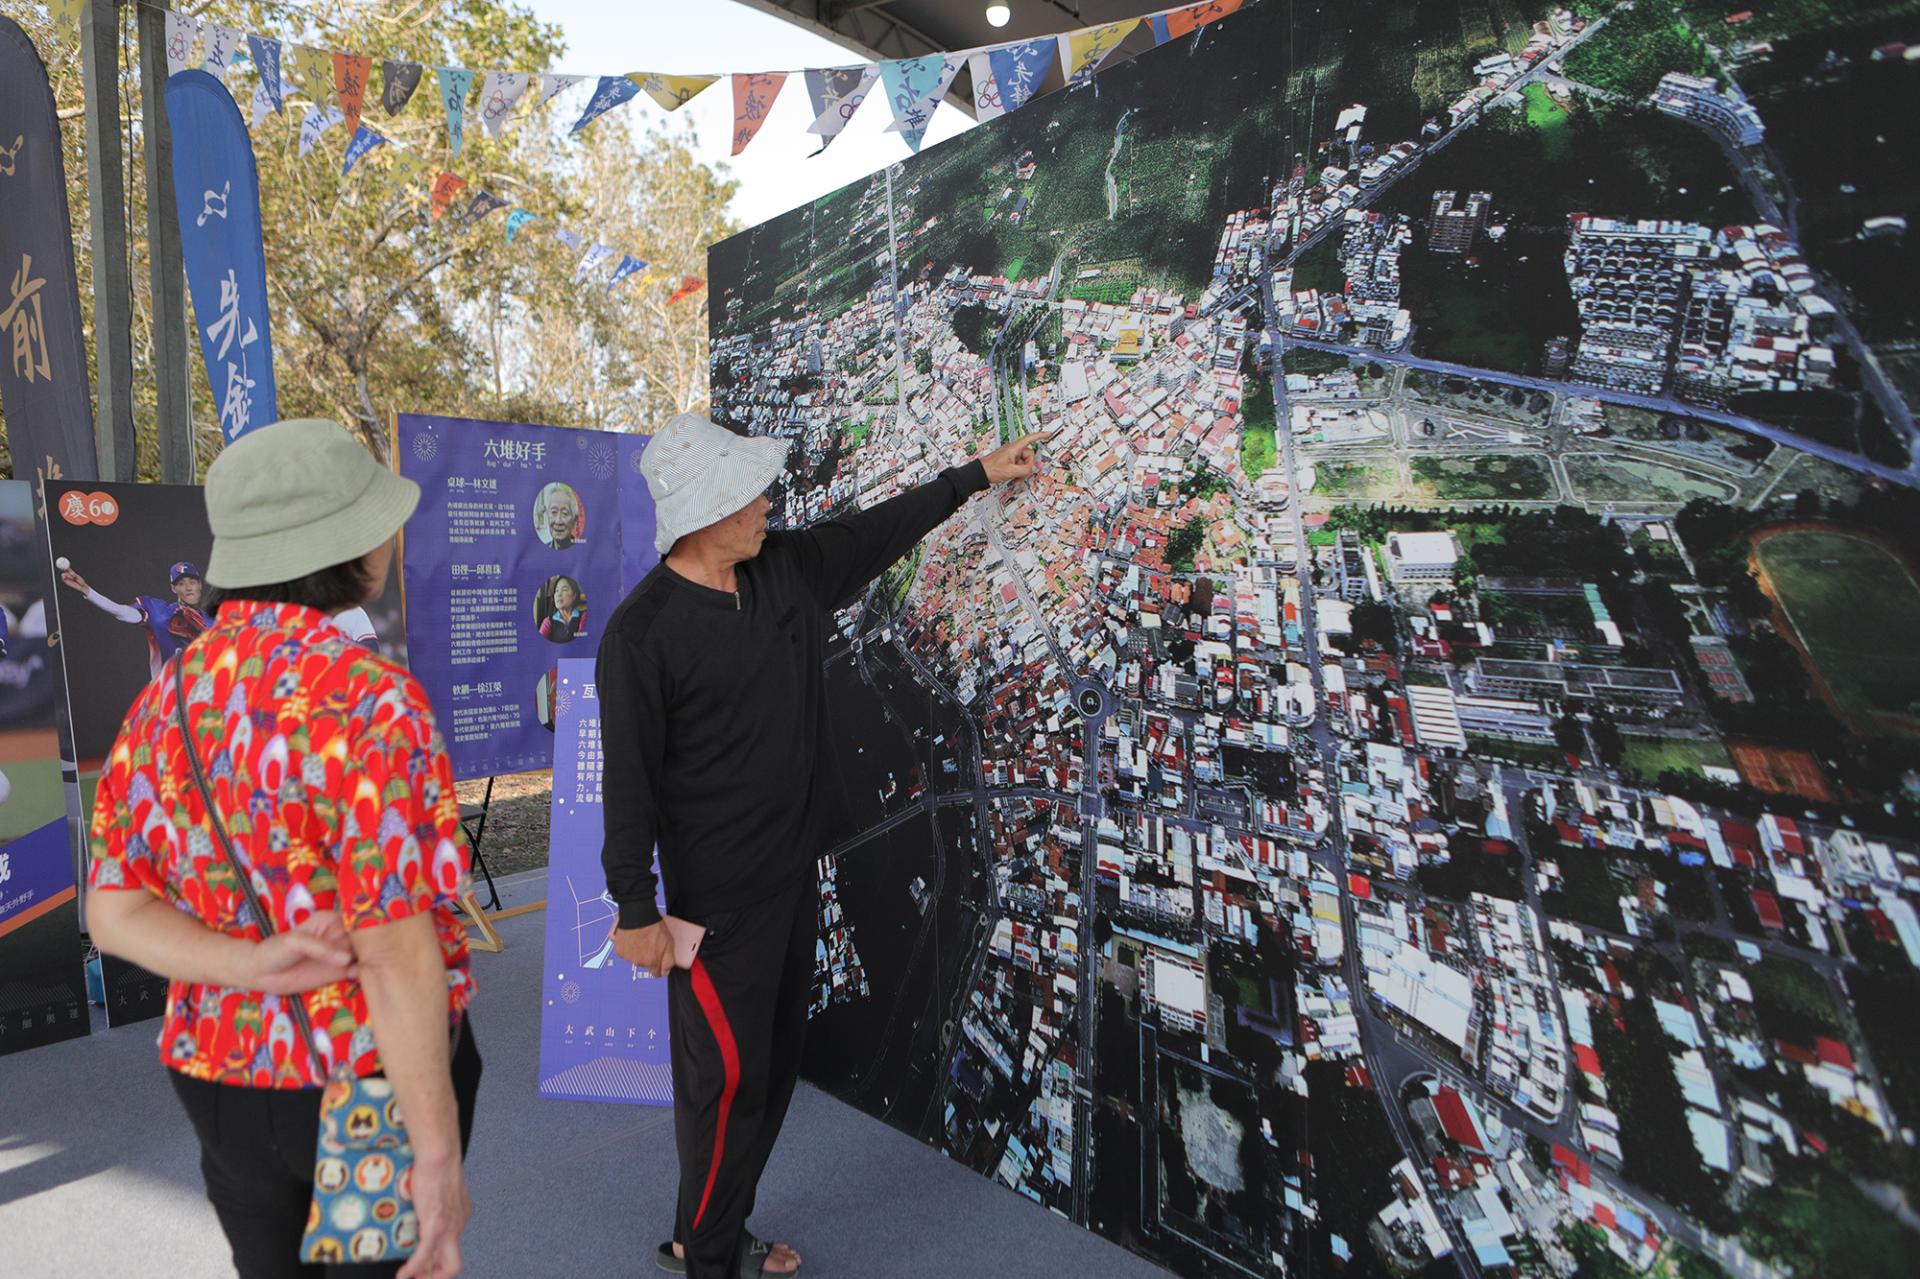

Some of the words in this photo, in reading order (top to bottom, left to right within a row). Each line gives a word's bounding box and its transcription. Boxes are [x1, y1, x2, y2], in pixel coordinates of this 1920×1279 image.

[484, 439, 546, 461] 六堆好手
[579, 719, 601, 728] 六堆
[565, 1024, 671, 1041] 大武山下个
